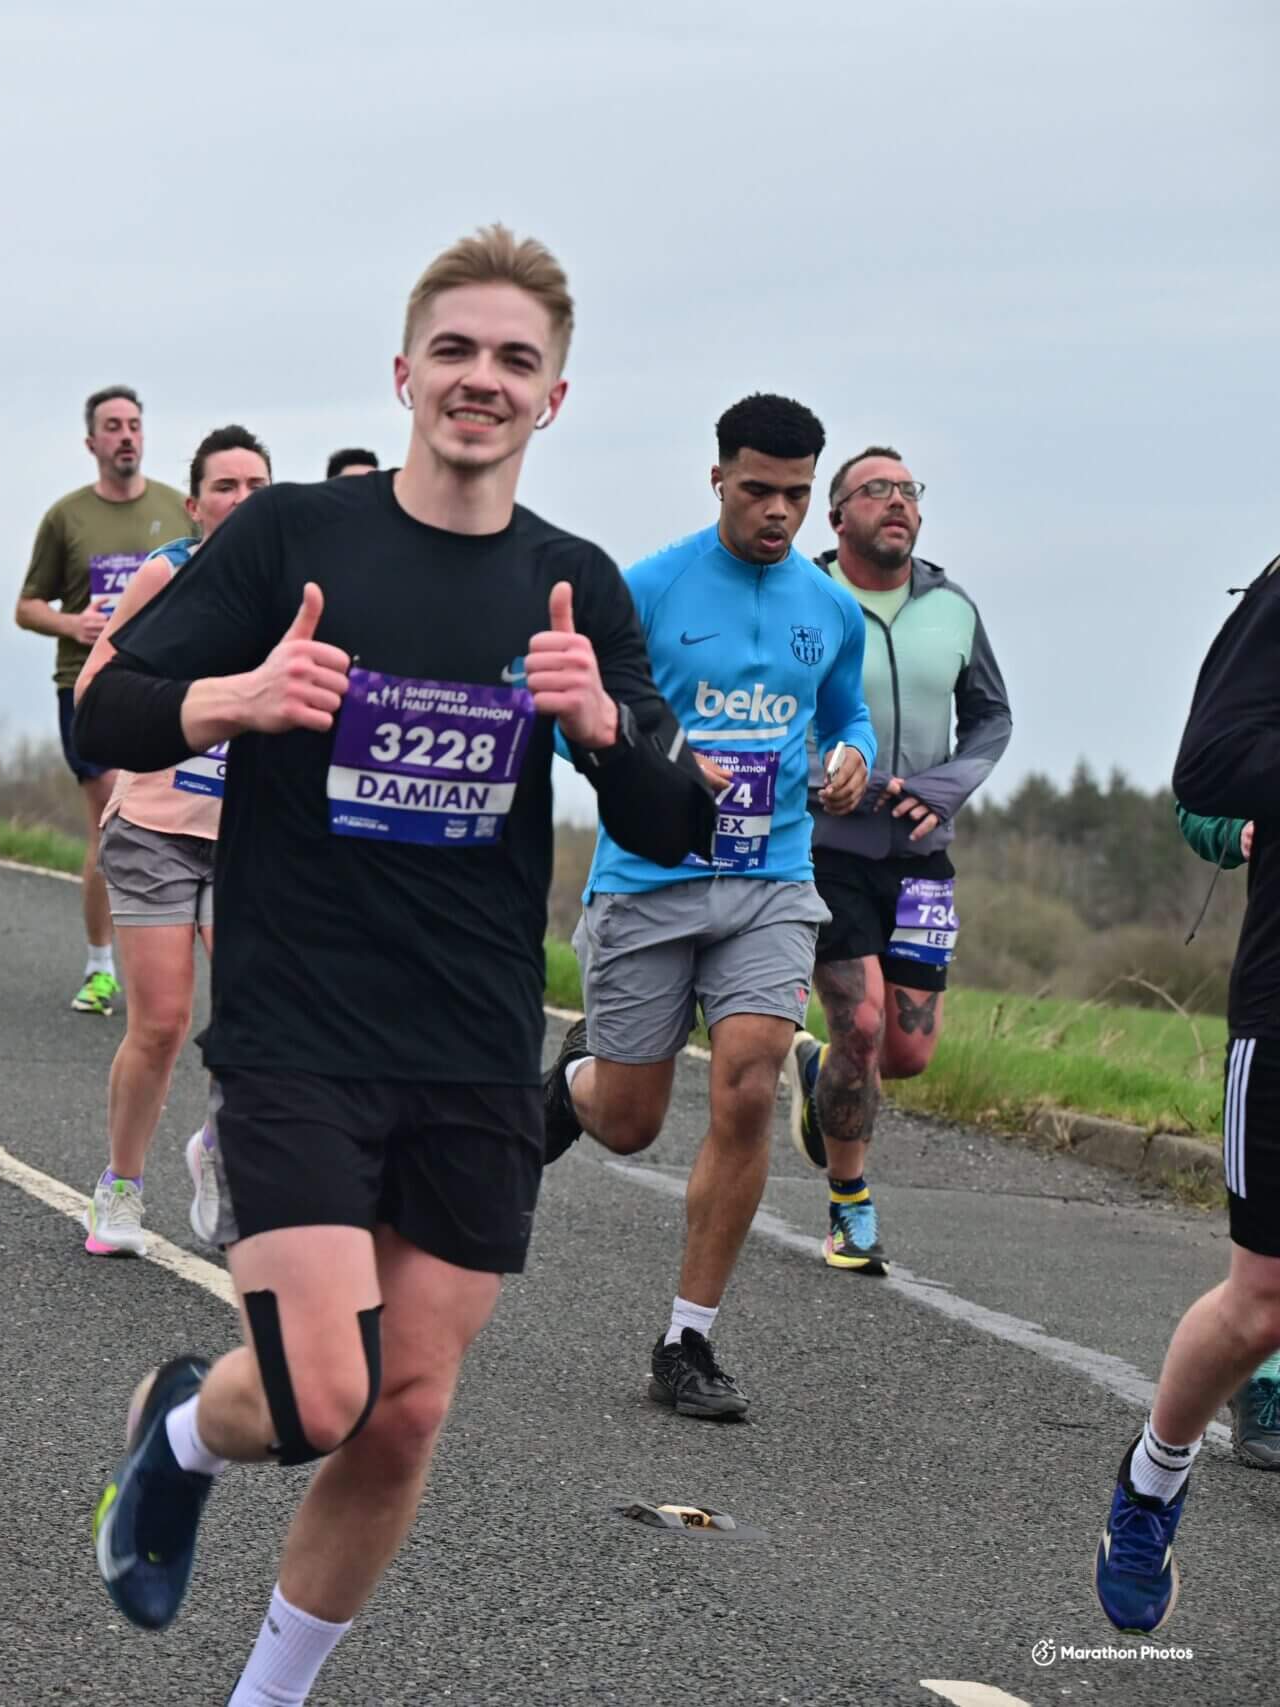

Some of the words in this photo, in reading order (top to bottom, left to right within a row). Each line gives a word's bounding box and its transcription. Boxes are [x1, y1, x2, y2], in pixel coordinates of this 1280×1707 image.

[405, 686, 468, 703] SHEFFIELD
[695, 680, 798, 724] beko
[401, 699, 434, 713] HALF
[436, 703, 514, 720] MARATHON
[370, 722, 496, 773] 3228
[356, 774, 490, 810] DAMIAN
[926, 931, 949, 946] LEE
